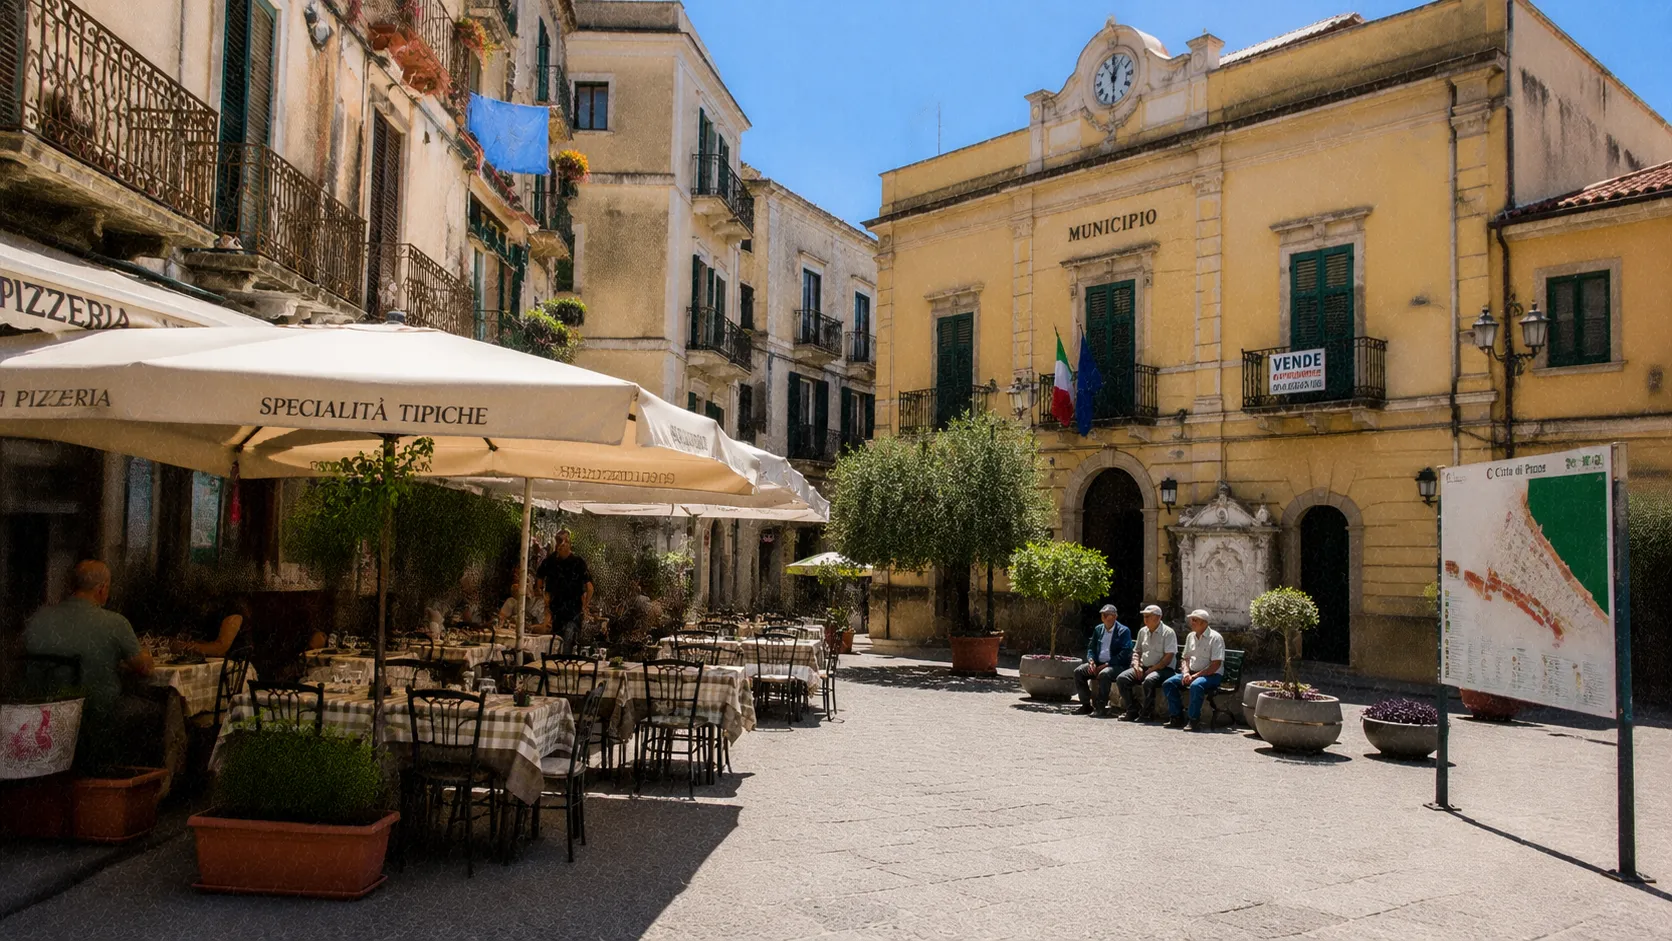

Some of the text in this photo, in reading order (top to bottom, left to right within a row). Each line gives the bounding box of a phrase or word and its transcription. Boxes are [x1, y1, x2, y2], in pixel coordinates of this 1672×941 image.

[1068, 208, 1157, 242] MUNICIPIO
[0, 276, 129, 328] PIZZERIA
[1273, 352, 1322, 371] VENDE
[14, 388, 112, 408] PIZZERIA
[259, 396, 488, 426] SPECIALITÀ TIPICHE
